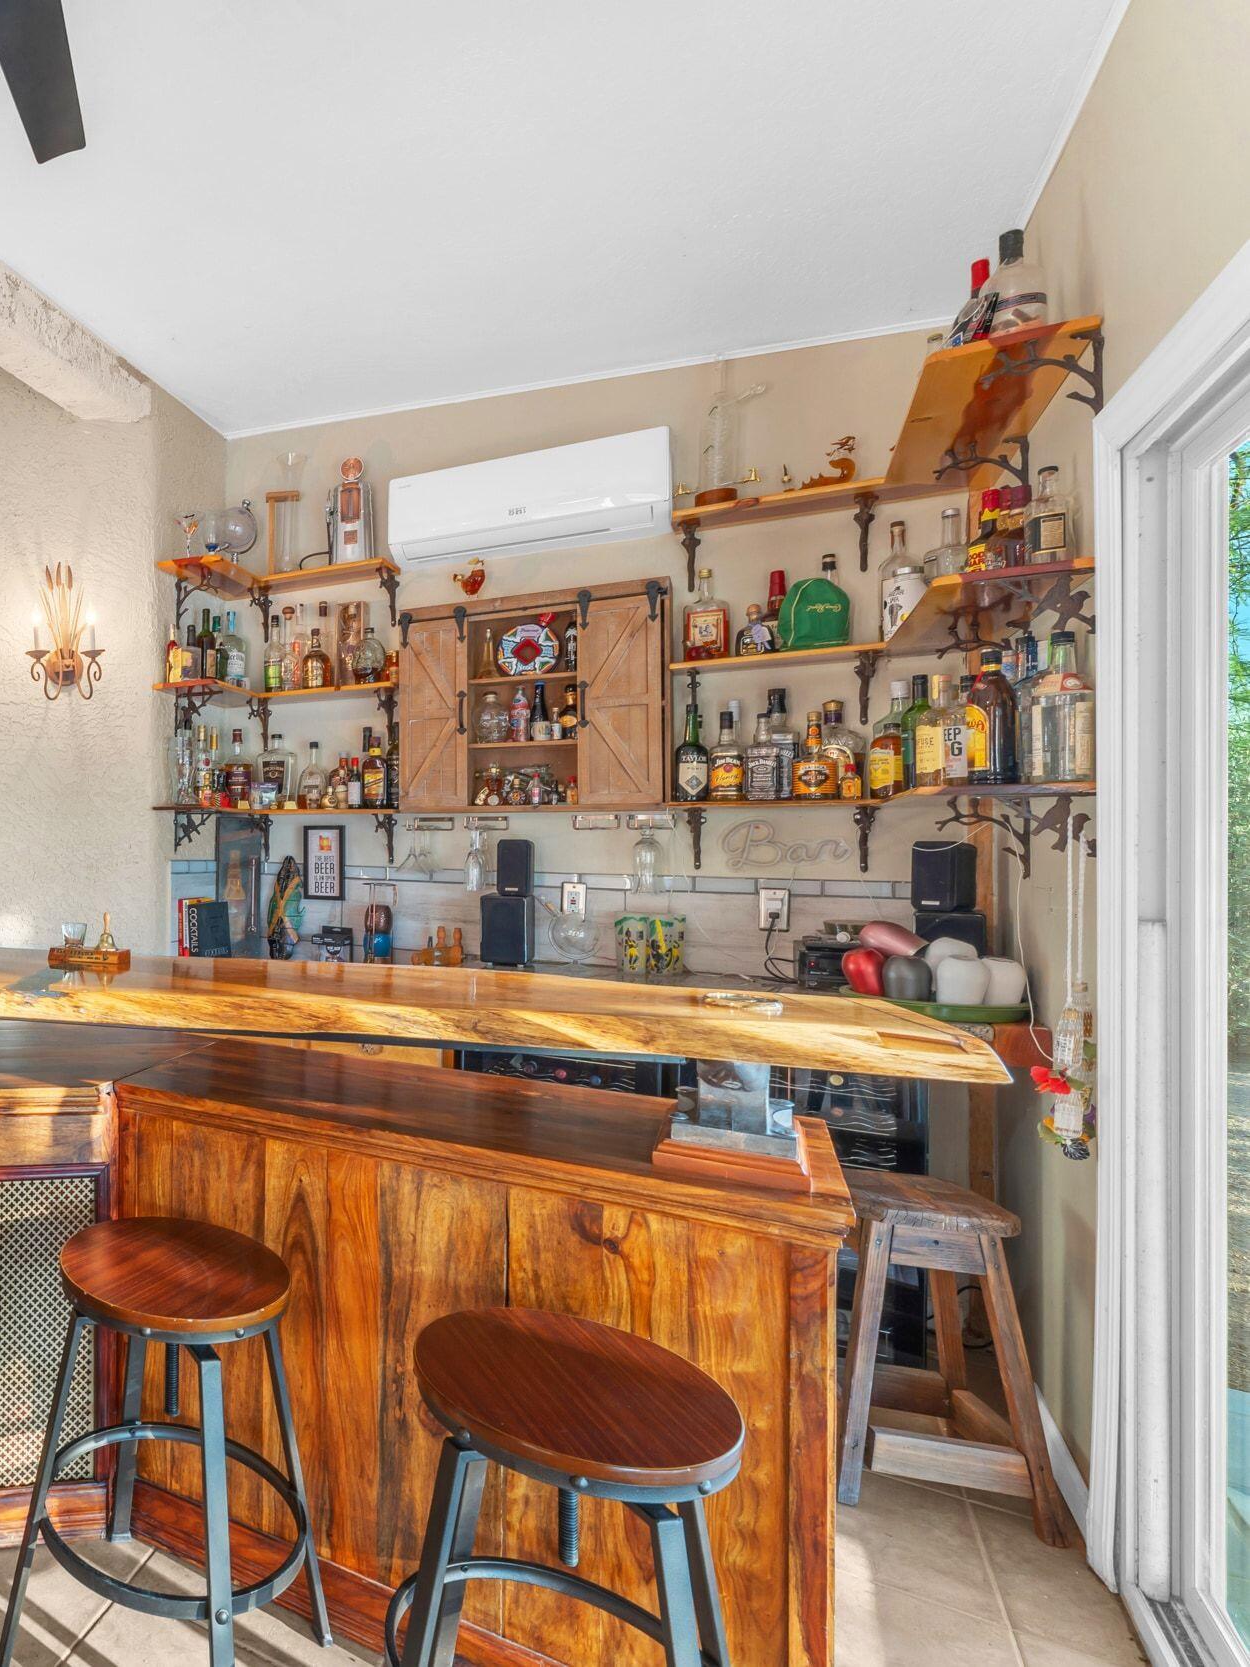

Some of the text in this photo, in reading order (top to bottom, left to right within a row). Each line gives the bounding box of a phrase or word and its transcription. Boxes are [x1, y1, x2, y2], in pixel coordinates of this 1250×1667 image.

[722, 818, 852, 870] Bar
[314, 862, 335, 875] BEER
[314, 881, 335, 894] BEER
[189, 907, 199, 953] COCKTAILS
